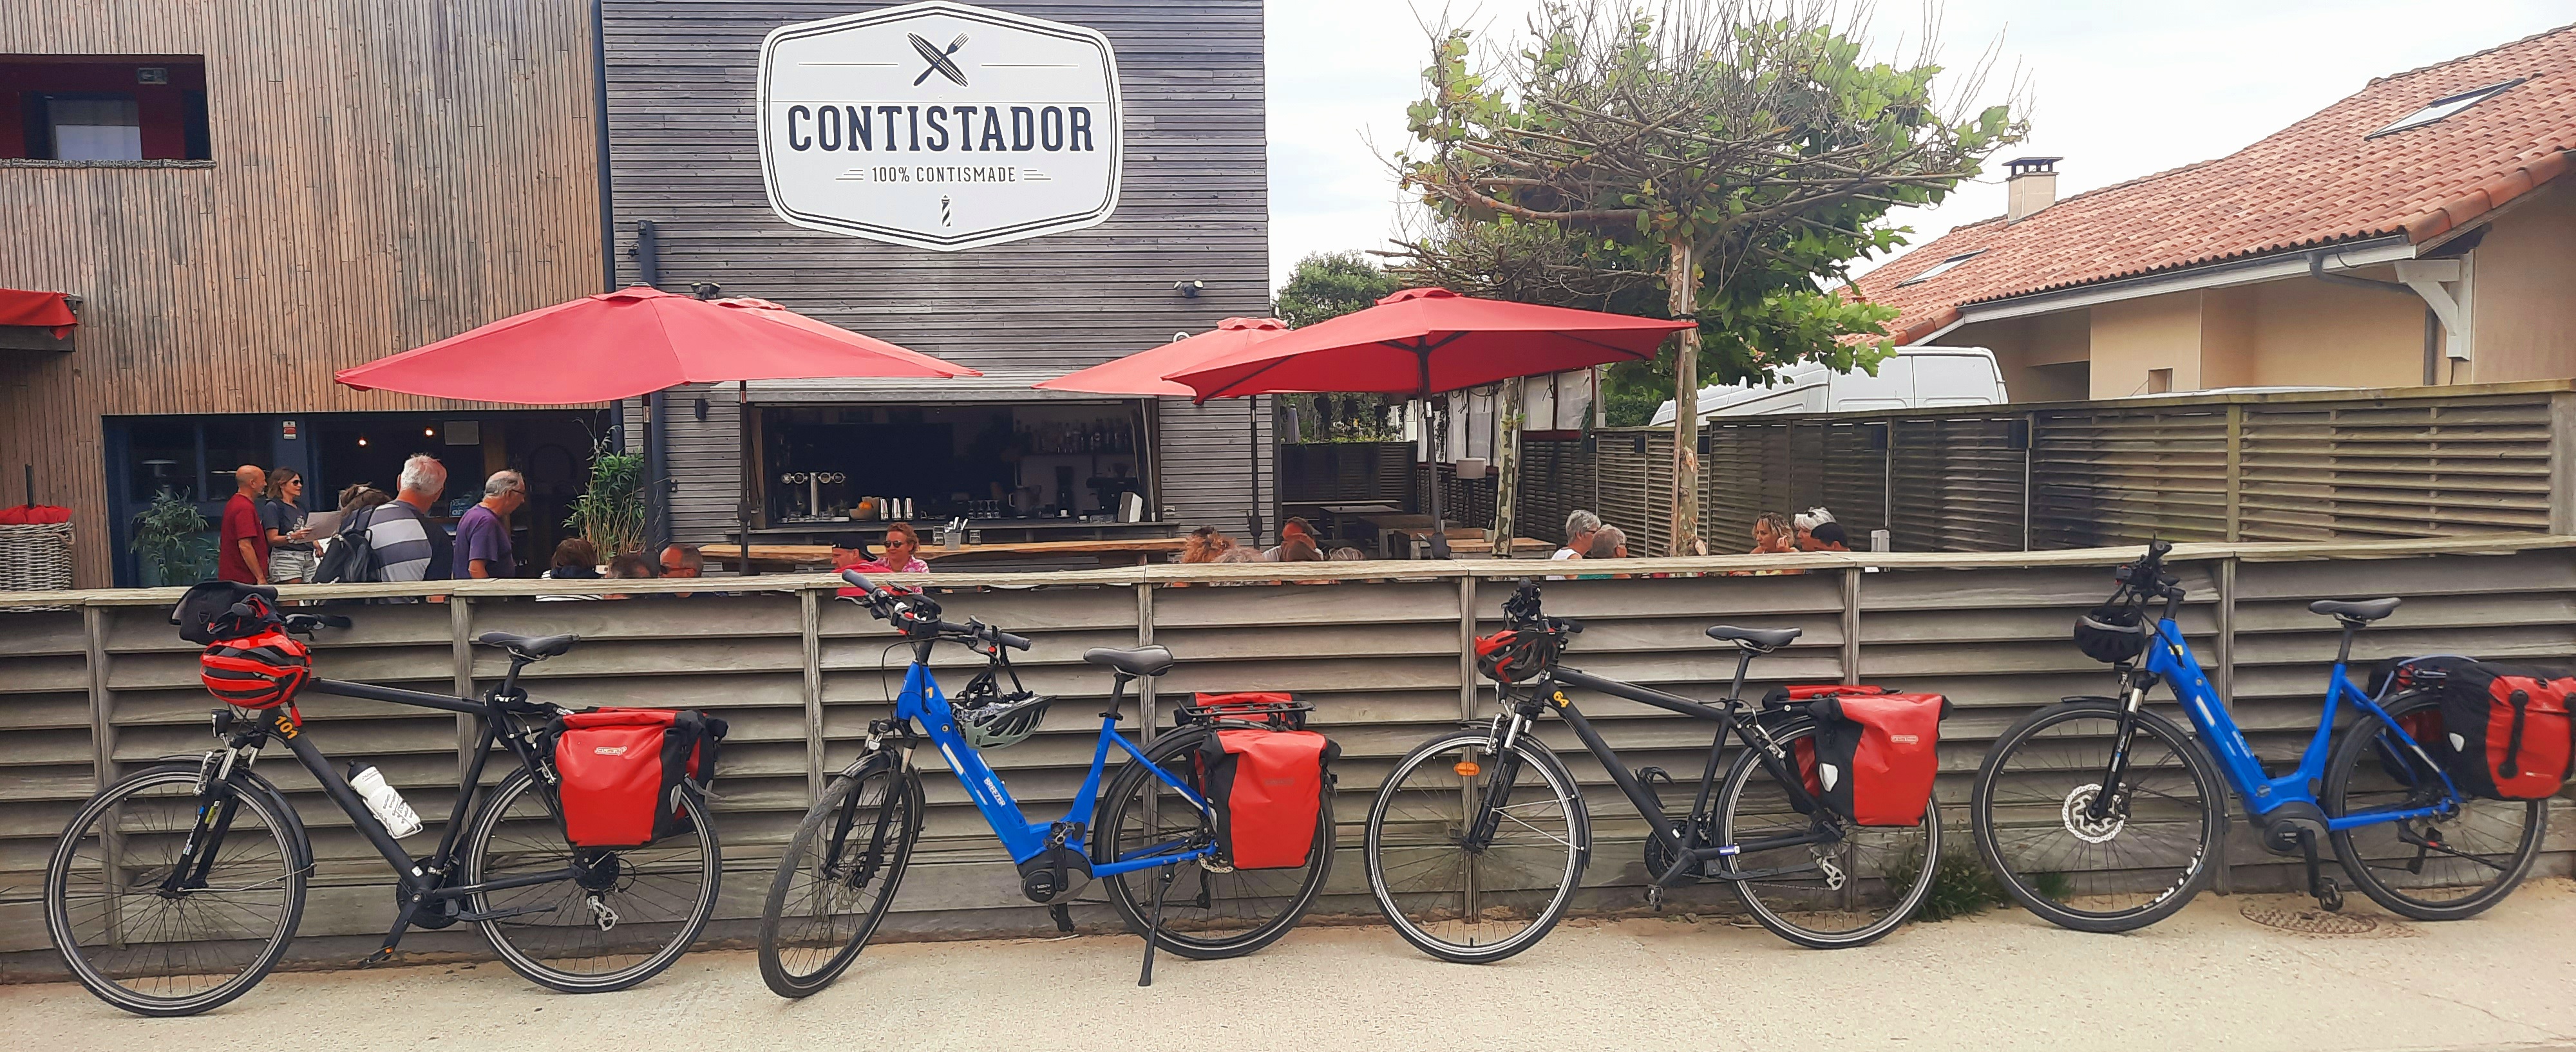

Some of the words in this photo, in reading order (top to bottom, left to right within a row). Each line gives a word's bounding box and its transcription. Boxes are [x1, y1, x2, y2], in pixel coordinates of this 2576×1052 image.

[788, 105, 1094, 152] CONTISTADOR
[872, 167, 910, 182] 100%
[916, 167, 1016, 182] CONTISMADE
[1553, 691, 1569, 708] 64
[274, 715, 298, 739] 101
[983, 776, 1006, 807] BREEZER
